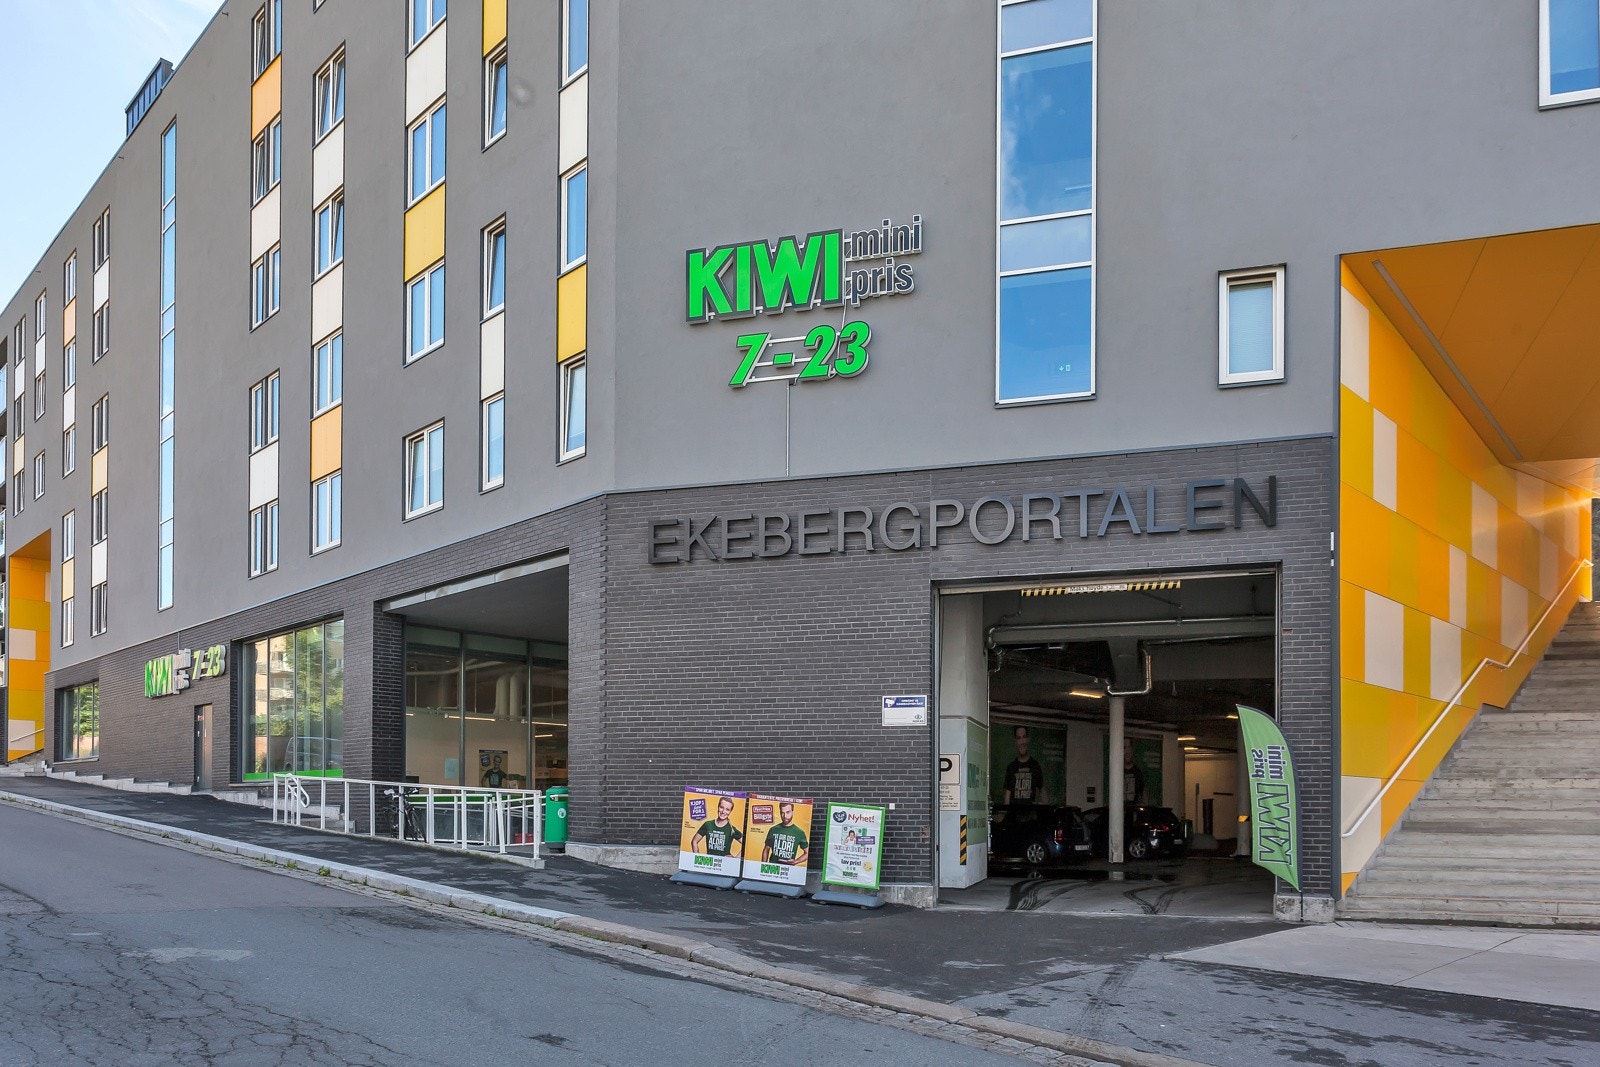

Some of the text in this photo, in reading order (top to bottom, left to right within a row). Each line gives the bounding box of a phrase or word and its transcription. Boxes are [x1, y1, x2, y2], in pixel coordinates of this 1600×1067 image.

[850, 214, 922, 259] mini
[686, 229, 844, 323] KIWI
[850, 257, 914, 307] pris
[647, 475, 1277, 565] EKEBERGPORTALEN
[145, 654, 175, 698] KIWI
[939, 757, 953, 781] P
[848, 813, 875, 823] Nyhet!
[694, 855, 714, 867] KIWI
[760, 864, 780, 876] KIWI
